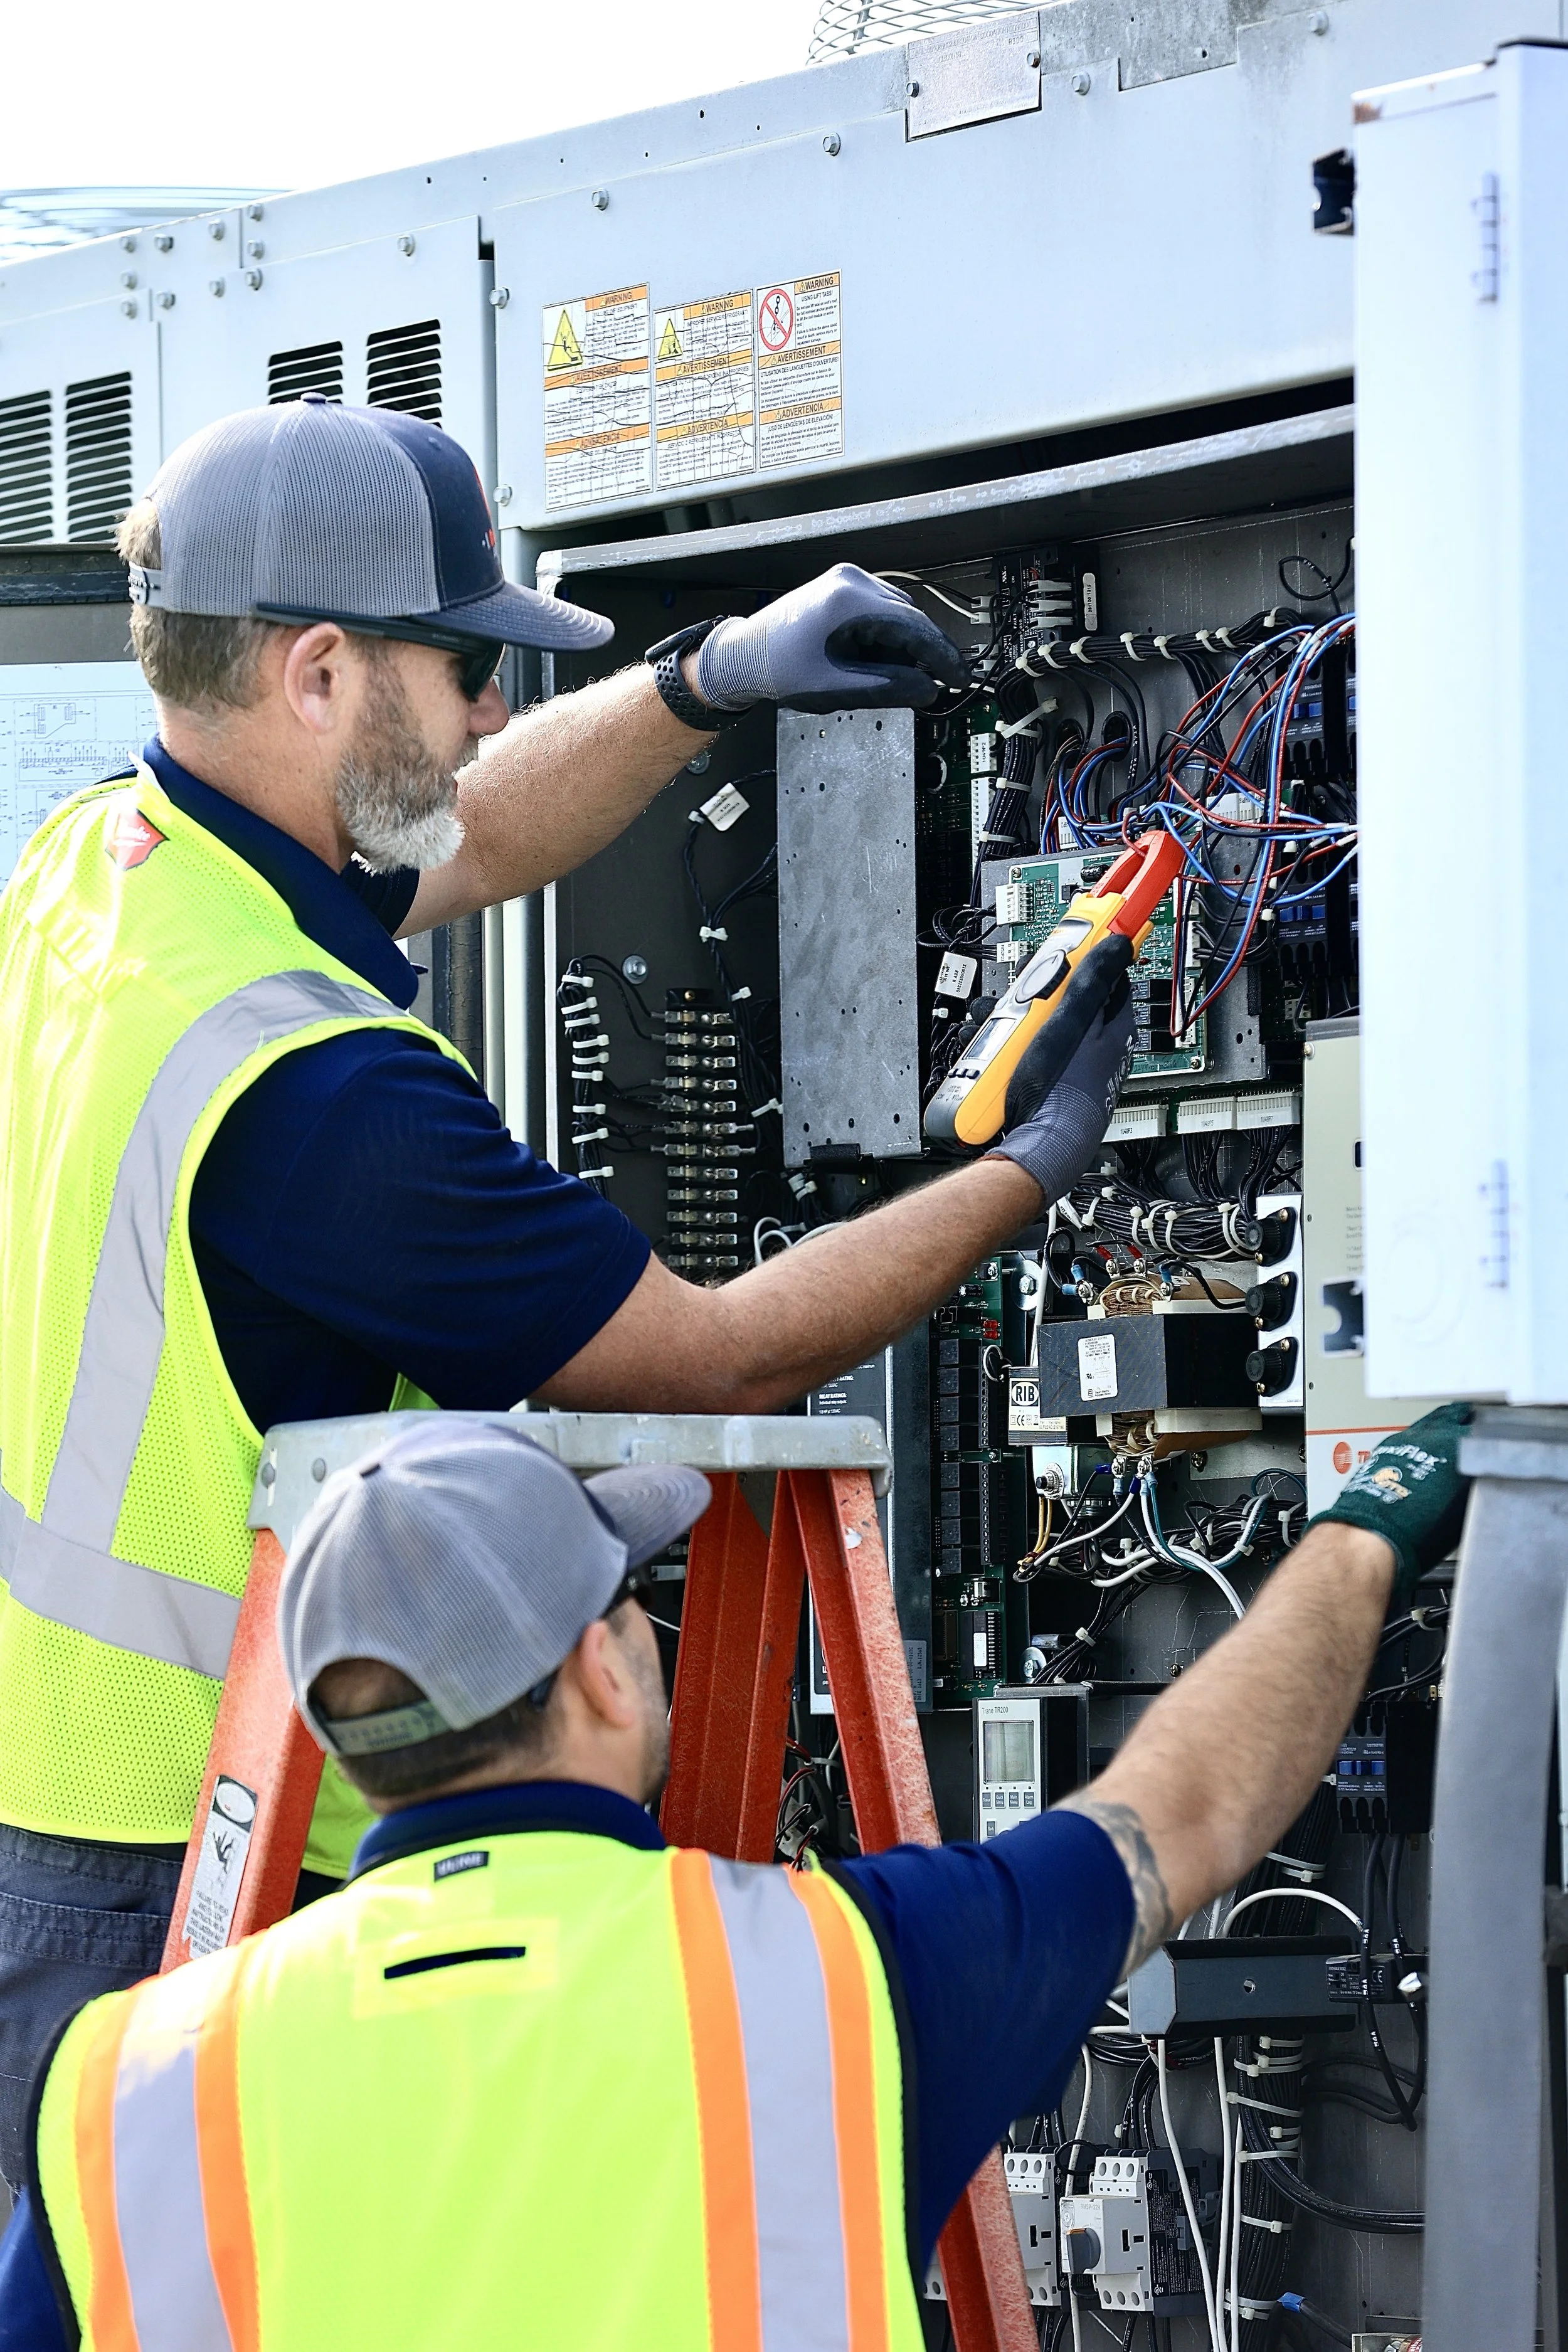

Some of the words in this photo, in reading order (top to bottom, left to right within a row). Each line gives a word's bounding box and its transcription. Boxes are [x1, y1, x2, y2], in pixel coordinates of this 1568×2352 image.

[805, 277, 833, 290] WARNING
[706, 300, 733, 312] WARNING
[778, 346, 825, 363] AVERTISSEMENT
[683, 356, 730, 374] AVERTISSEMENT
[790, 363, 812, 371] LANGUETTES
[782, 403, 823, 418] ADVERTENCIA
[688, 419, 728, 433] ADVERTENCIA
[1016, 1386, 1035, 1401] RIB
